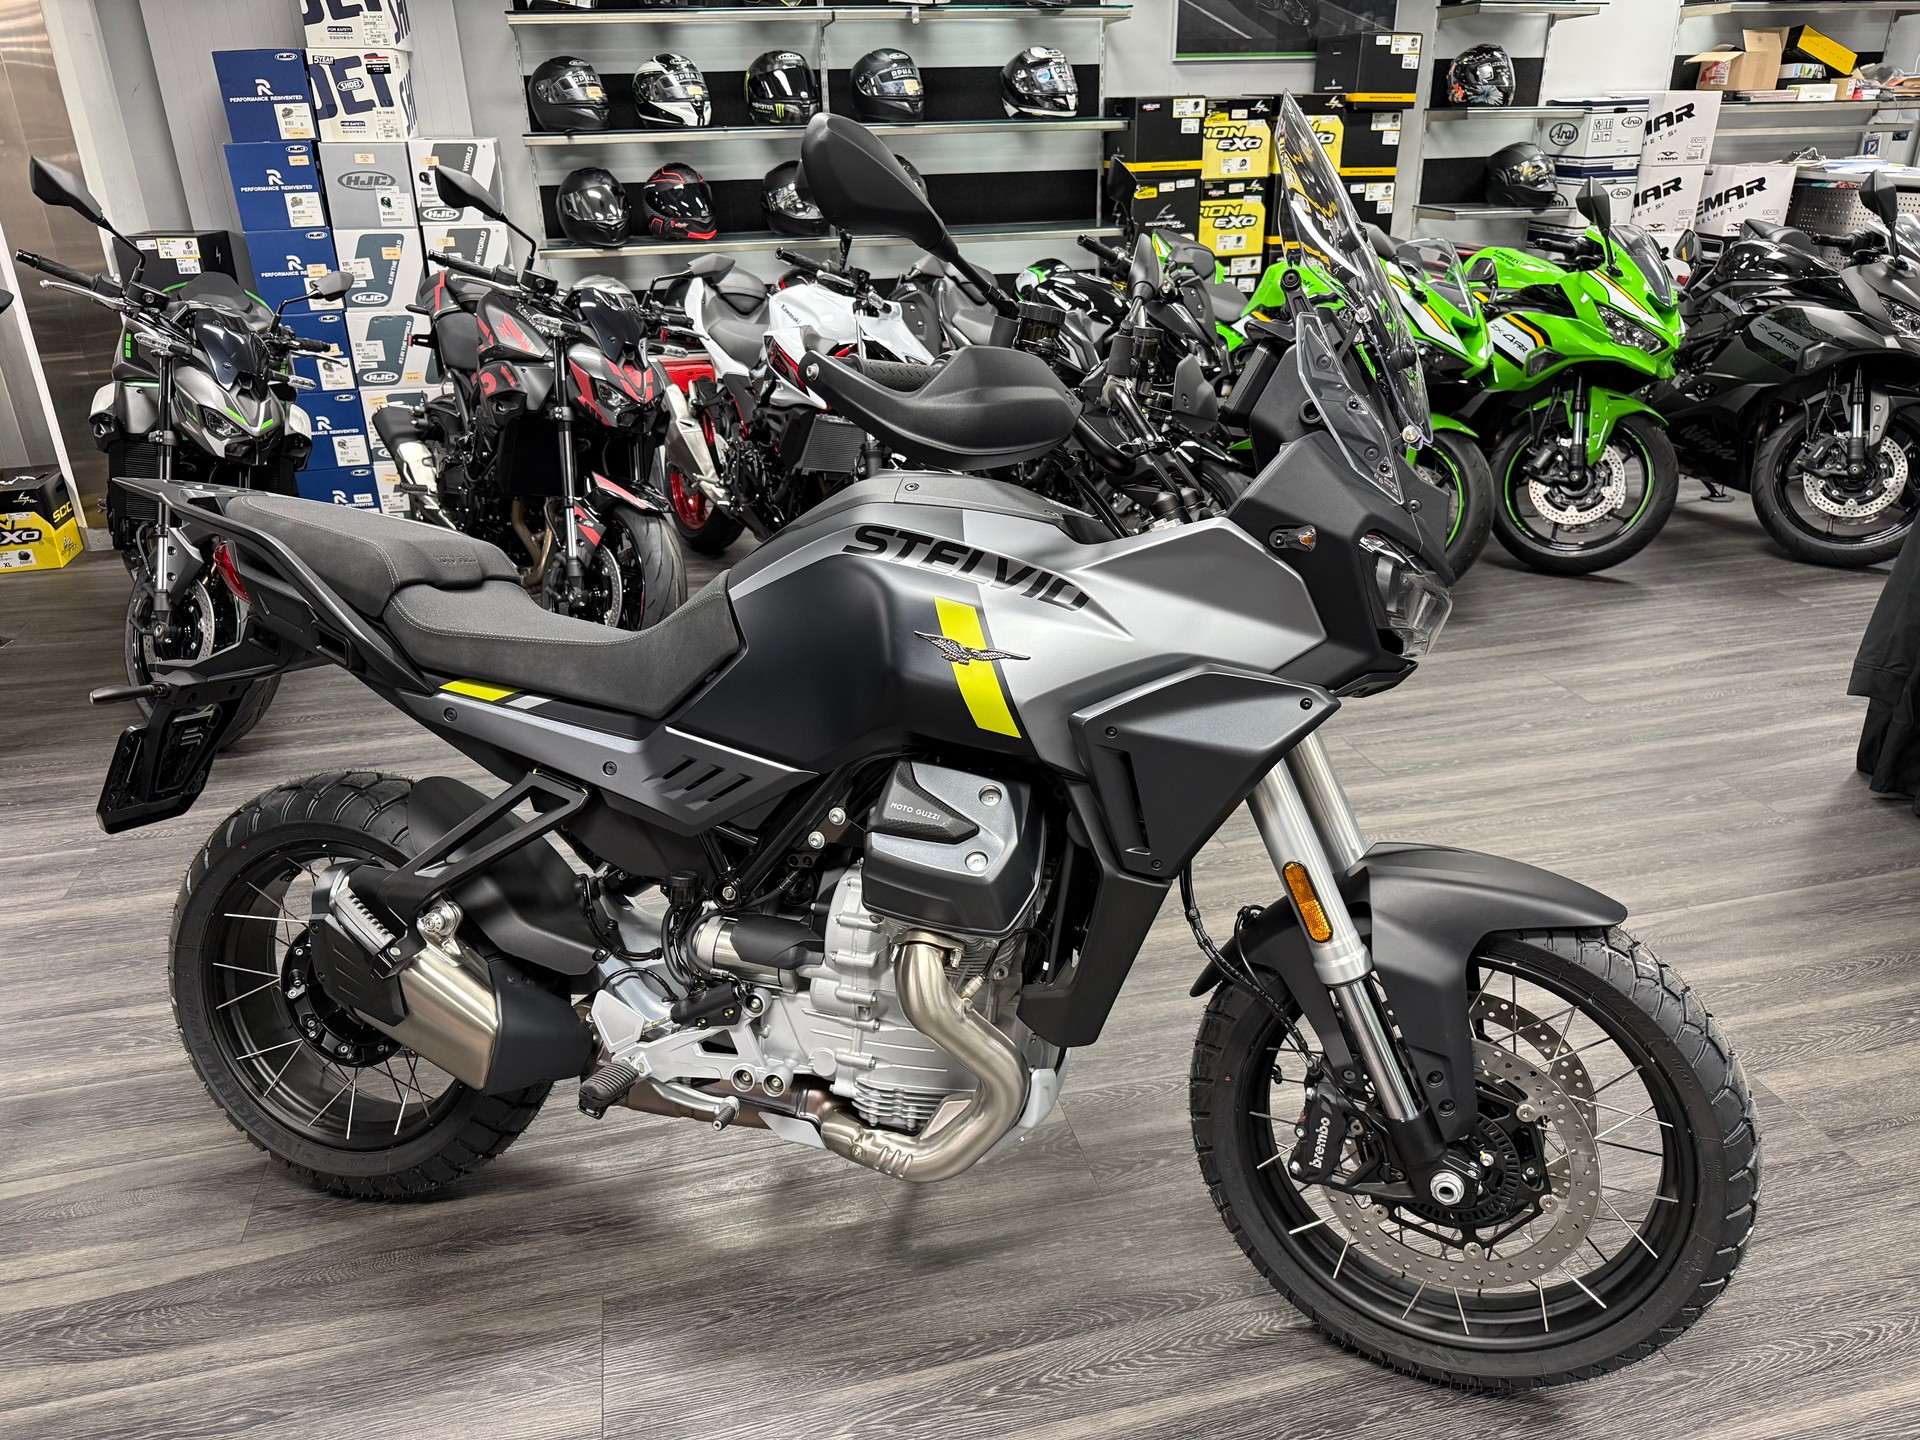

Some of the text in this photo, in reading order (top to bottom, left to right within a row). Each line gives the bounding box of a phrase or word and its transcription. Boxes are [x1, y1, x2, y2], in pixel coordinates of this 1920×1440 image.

[340, 81, 360, 90] SHOEI
[462, 146, 474, 172] WORLD
[1696, 204, 1744, 225] HELMETS
[477, 231, 487, 254] WORLD
[781, 303, 801, 325] Kawasaki
[1680, 424, 1738, 460] Ninja
[842, 524, 1090, 612] STELVIO
[890, 802, 940, 820] MOTO GUZZI
[1309, 1117, 1330, 1169] brembo
